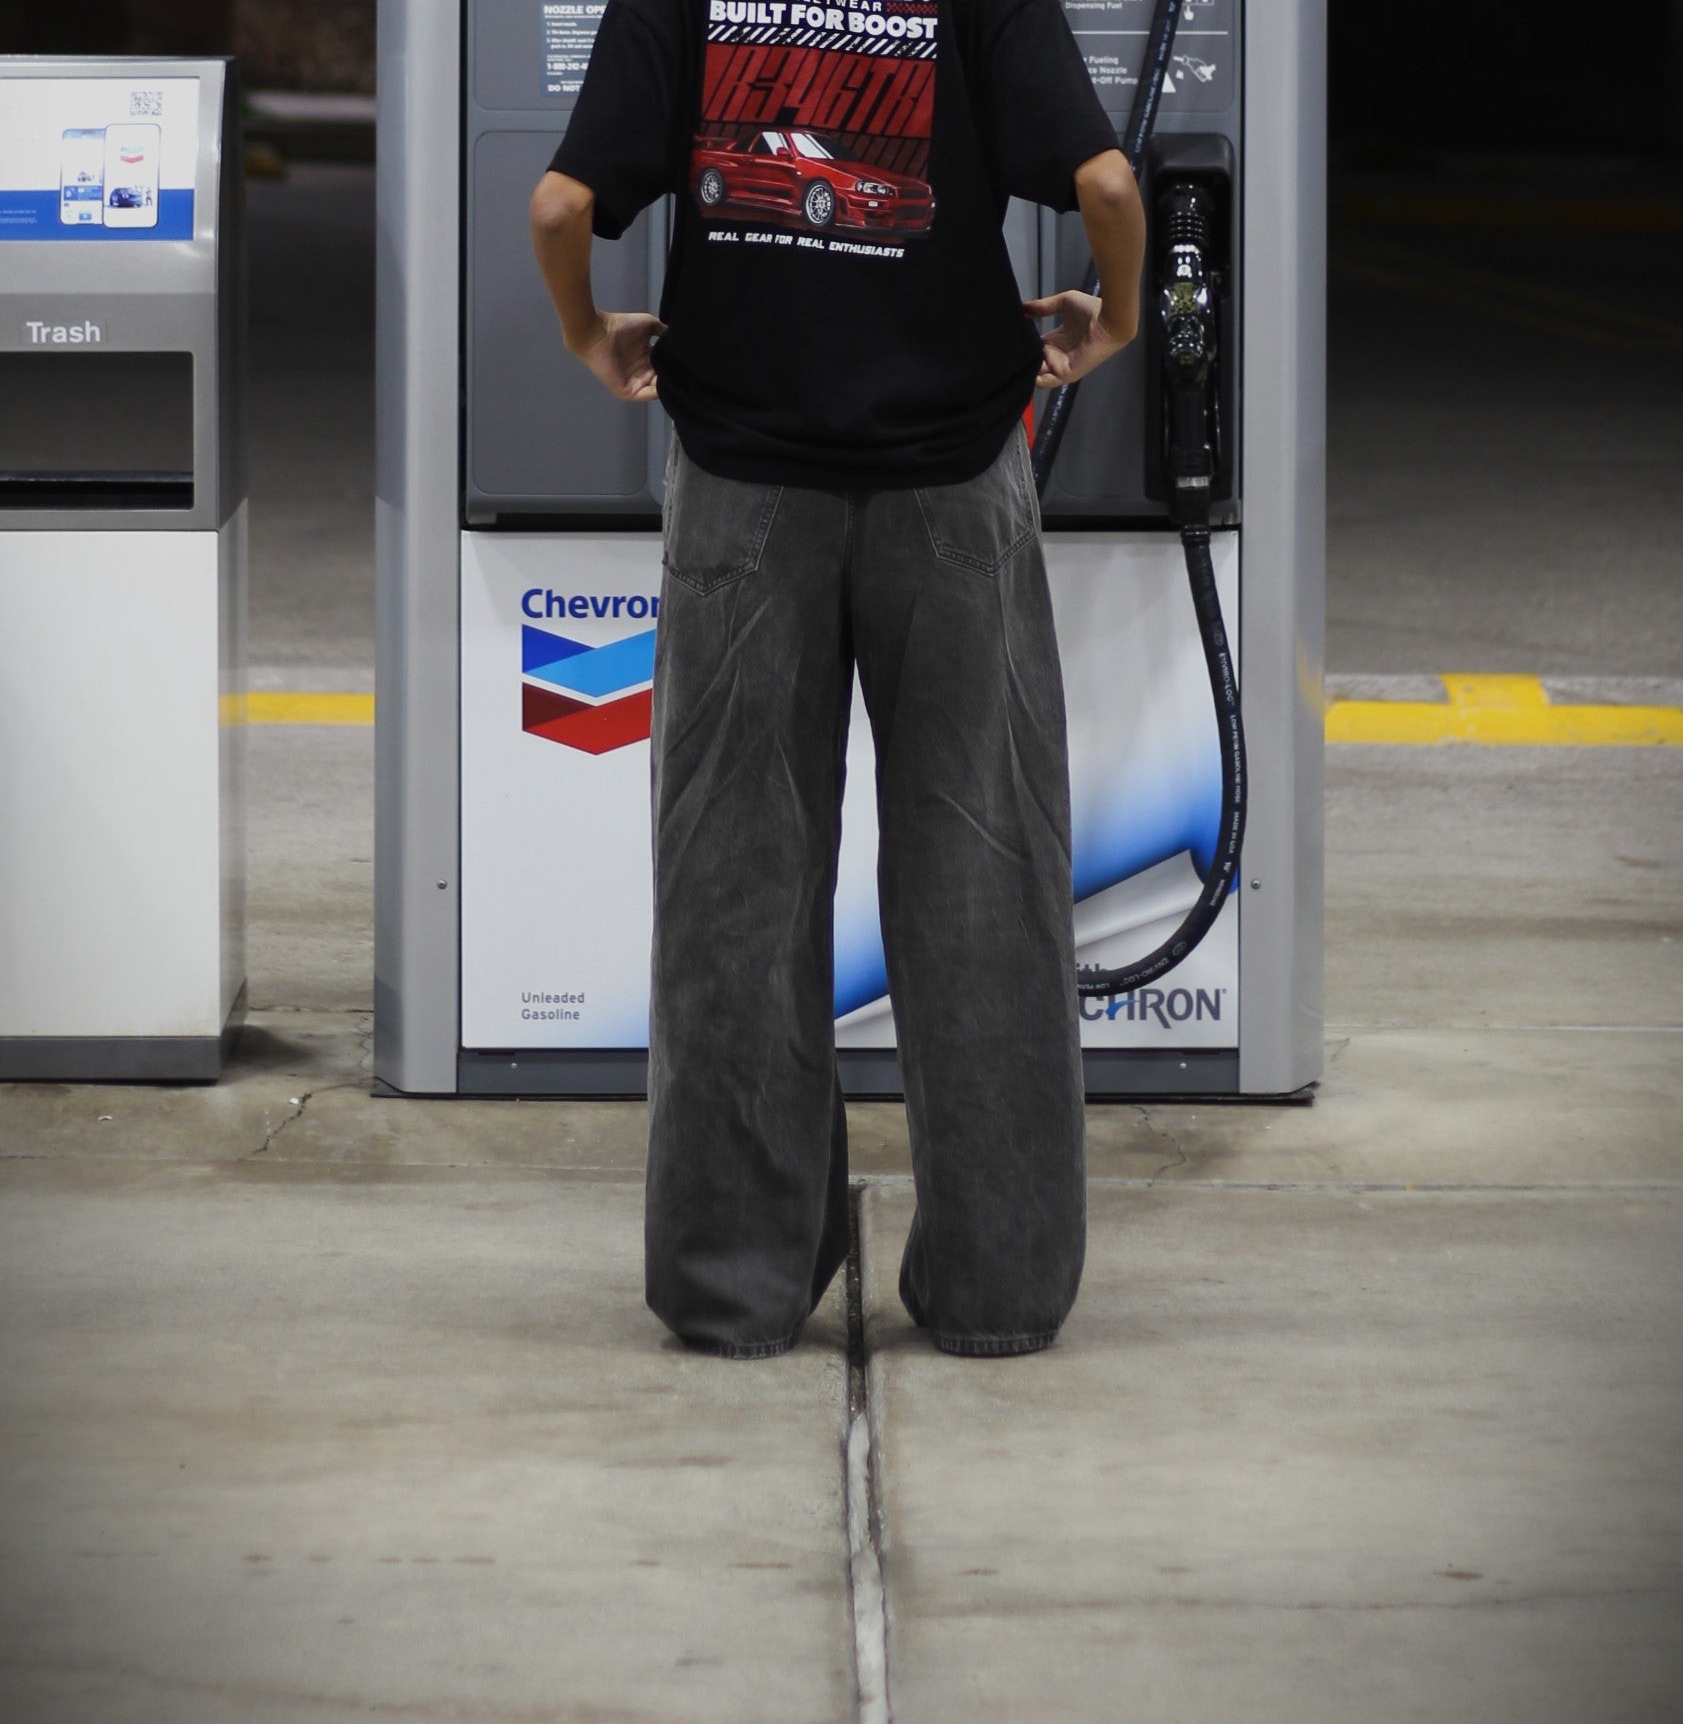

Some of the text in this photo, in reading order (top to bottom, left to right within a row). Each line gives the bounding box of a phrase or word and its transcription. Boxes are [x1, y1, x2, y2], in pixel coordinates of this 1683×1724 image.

[544, 5, 607, 14] NOZZLE OPE
[1065, 1, 1122, 10] Dispensing Fuel
[709, 0, 938, 39] BUILT FOR BOOST
[1089, 56, 1119, 65] Fueling
[1100, 66, 1127, 74] Nozzle
[1115, 76, 1138, 85] Pump
[548, 84, 581, 92] DO NOT
[708, 231, 904, 258] REAL GEAR FOR REAL ENTHUSIASTS
[26, 321, 101, 343] Trash
[521, 992, 585, 1004] Unleaded
[1079, 988, 1221, 1029] CHRON
[521, 1008, 581, 1020] Gasoline
